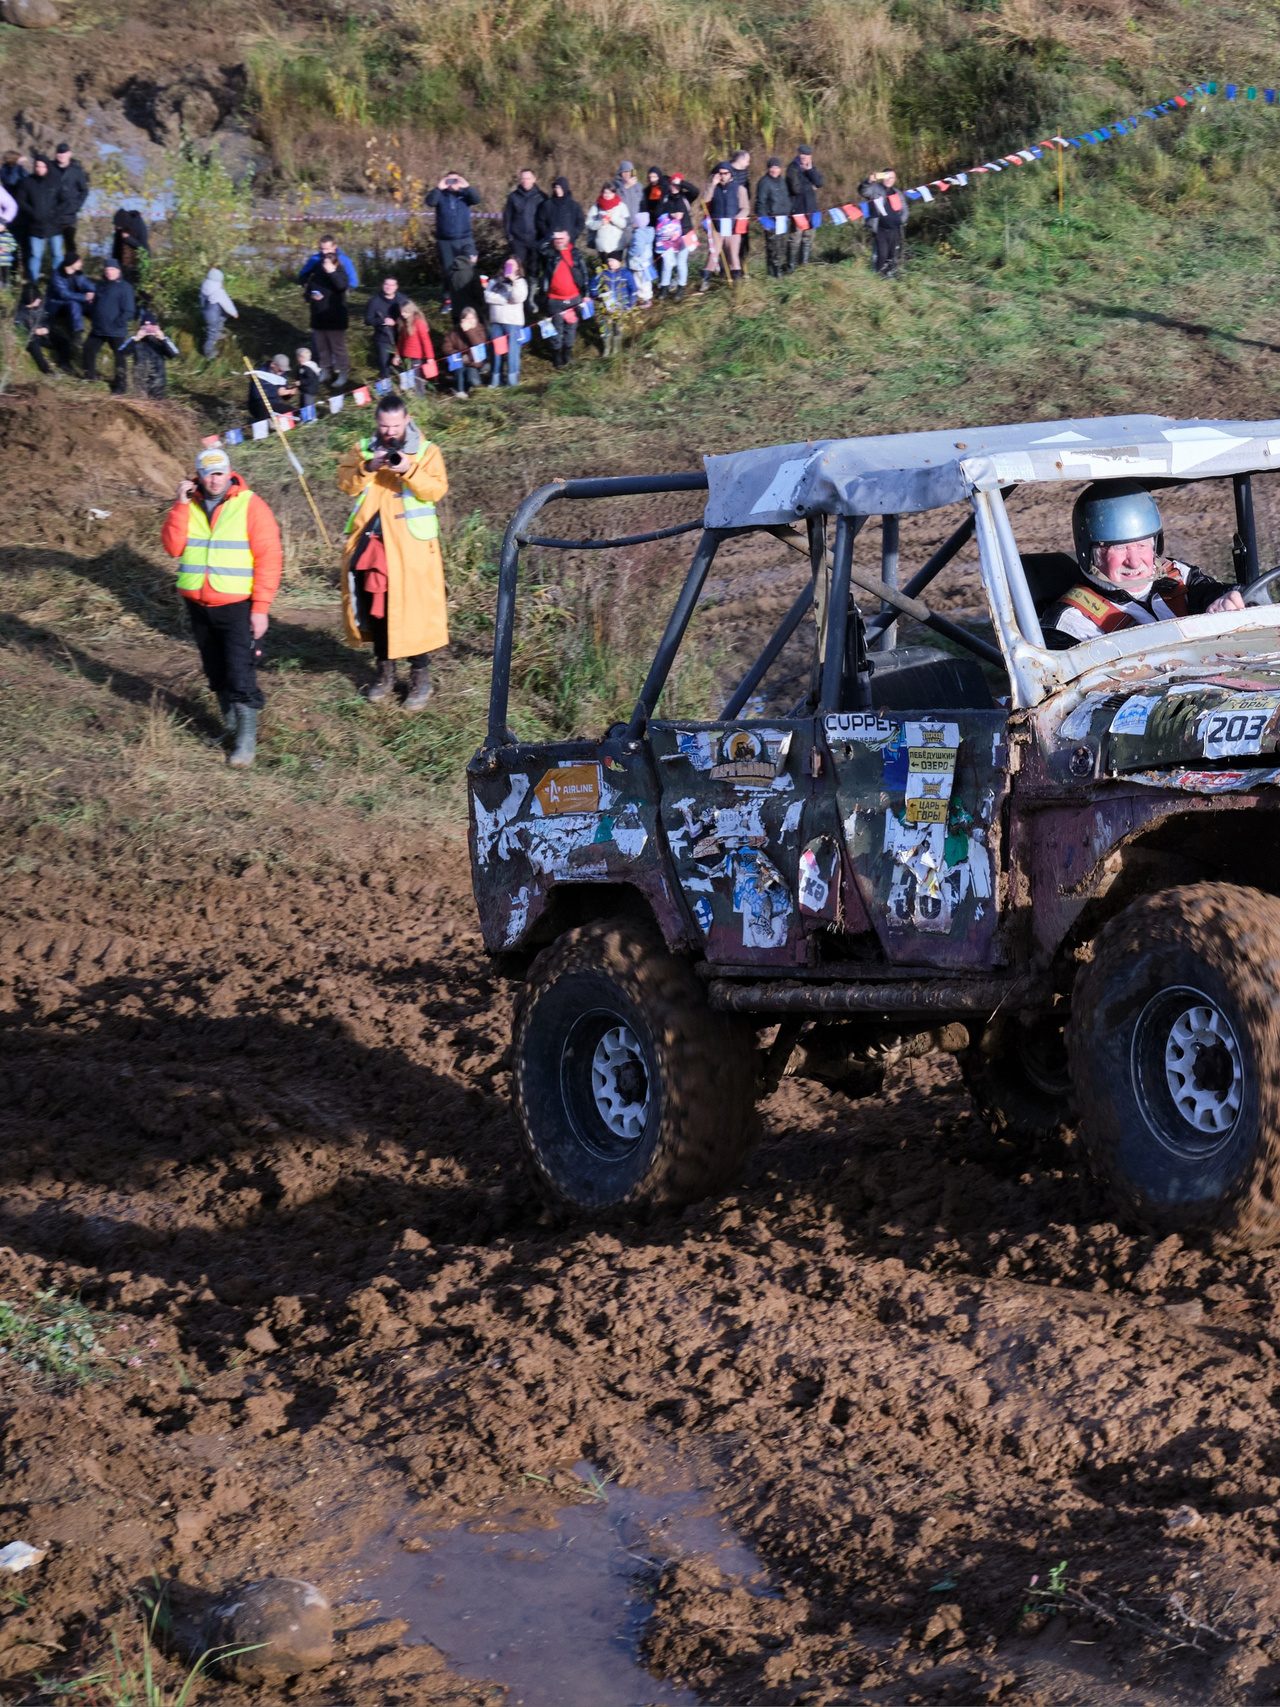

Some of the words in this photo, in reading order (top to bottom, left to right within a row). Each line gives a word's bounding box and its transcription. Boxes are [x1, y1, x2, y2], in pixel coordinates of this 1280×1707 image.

[826, 714, 900, 731] CUPPER
[1208, 715, 1268, 743] 203
[921, 761, 949, 770] ОЗЕРО
[563, 783, 593, 795] AIRLINE
[919, 801, 940, 810] ЦАРЬ
[917, 811, 941, 821] ГОРЫ
